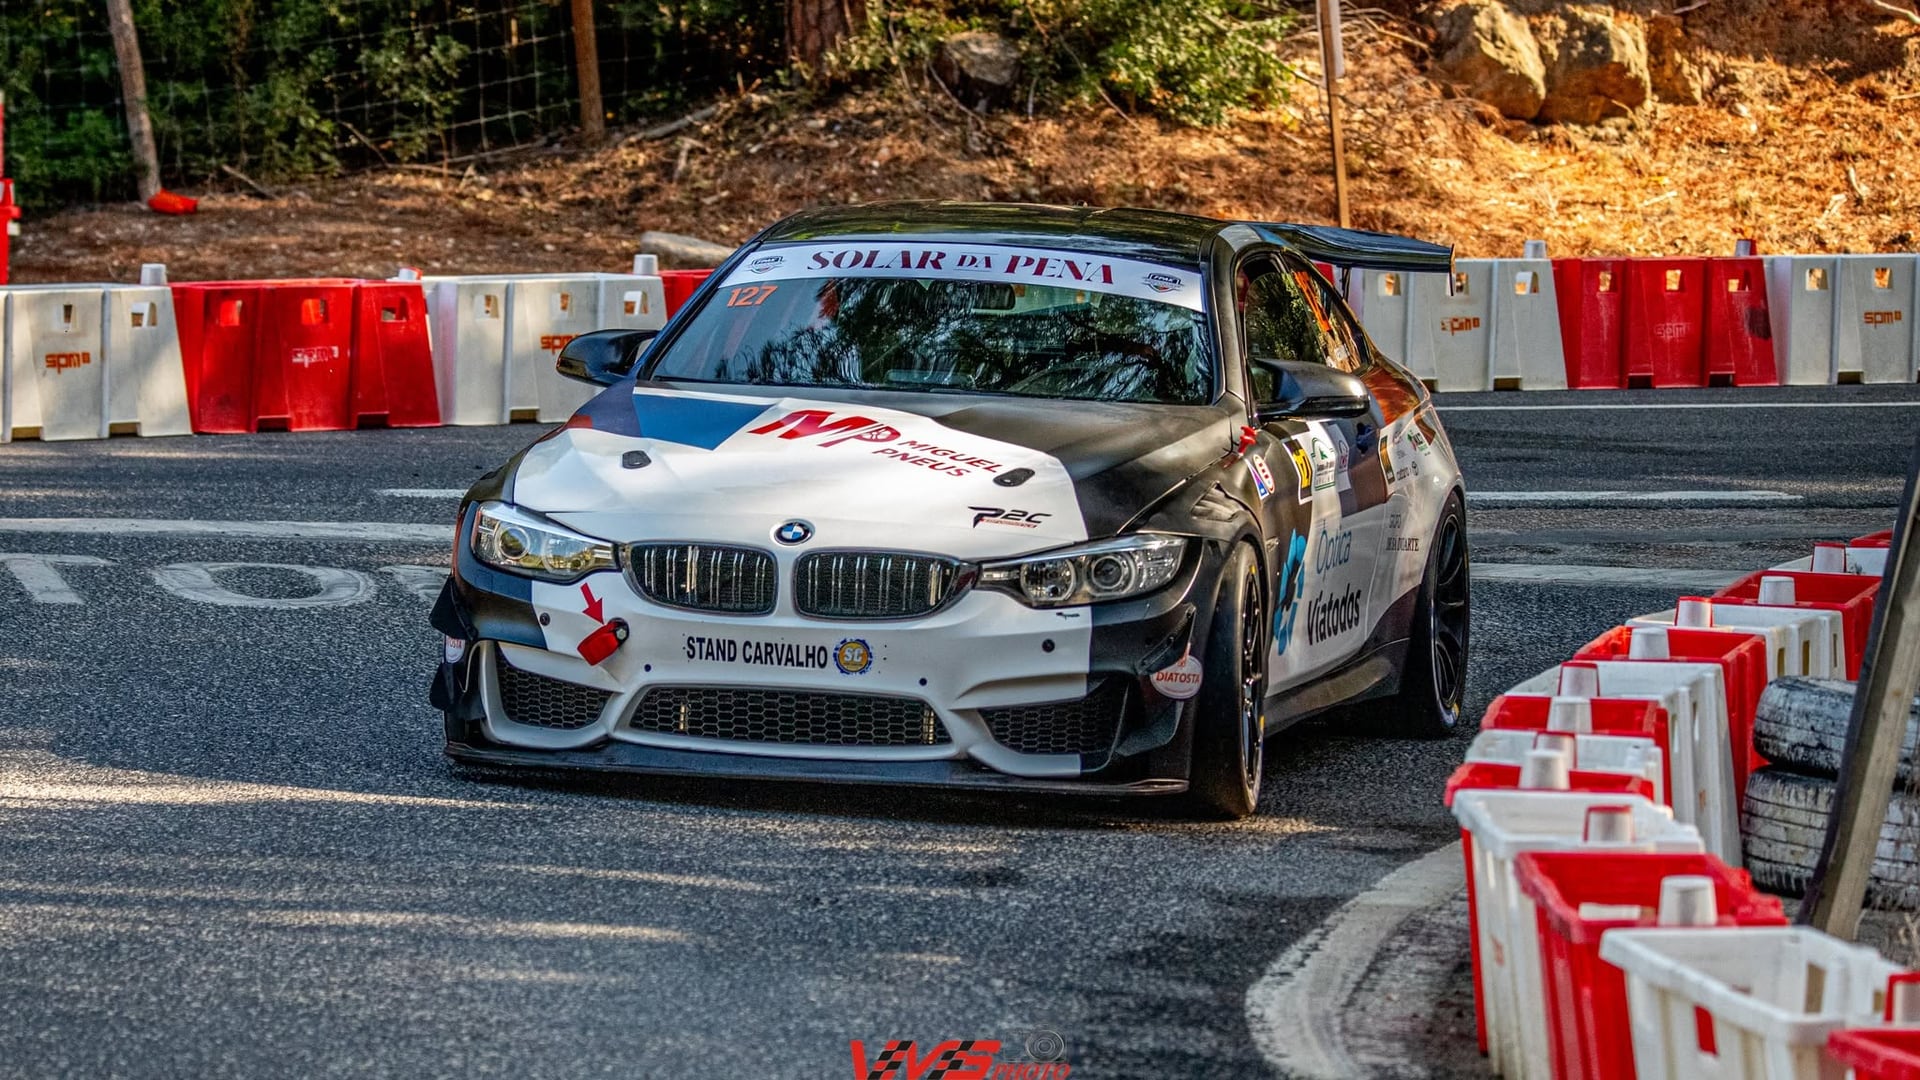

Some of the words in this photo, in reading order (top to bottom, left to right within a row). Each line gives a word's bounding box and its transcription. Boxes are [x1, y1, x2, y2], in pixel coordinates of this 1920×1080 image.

[807, 249, 947, 270] SOLAR
[956, 254, 993, 269] DA
[1003, 254, 1114, 285] PENA
[727, 285, 778, 307] 127
[871, 448, 972, 477] PNEUS
[897, 440, 1003, 473] MIGUEL
[967, 506, 1053, 528] P2C
[686, 636, 737, 663] STAND
[742, 640, 828, 669] CARVALHO
[1156, 672, 1200, 684] DIATOSTA
